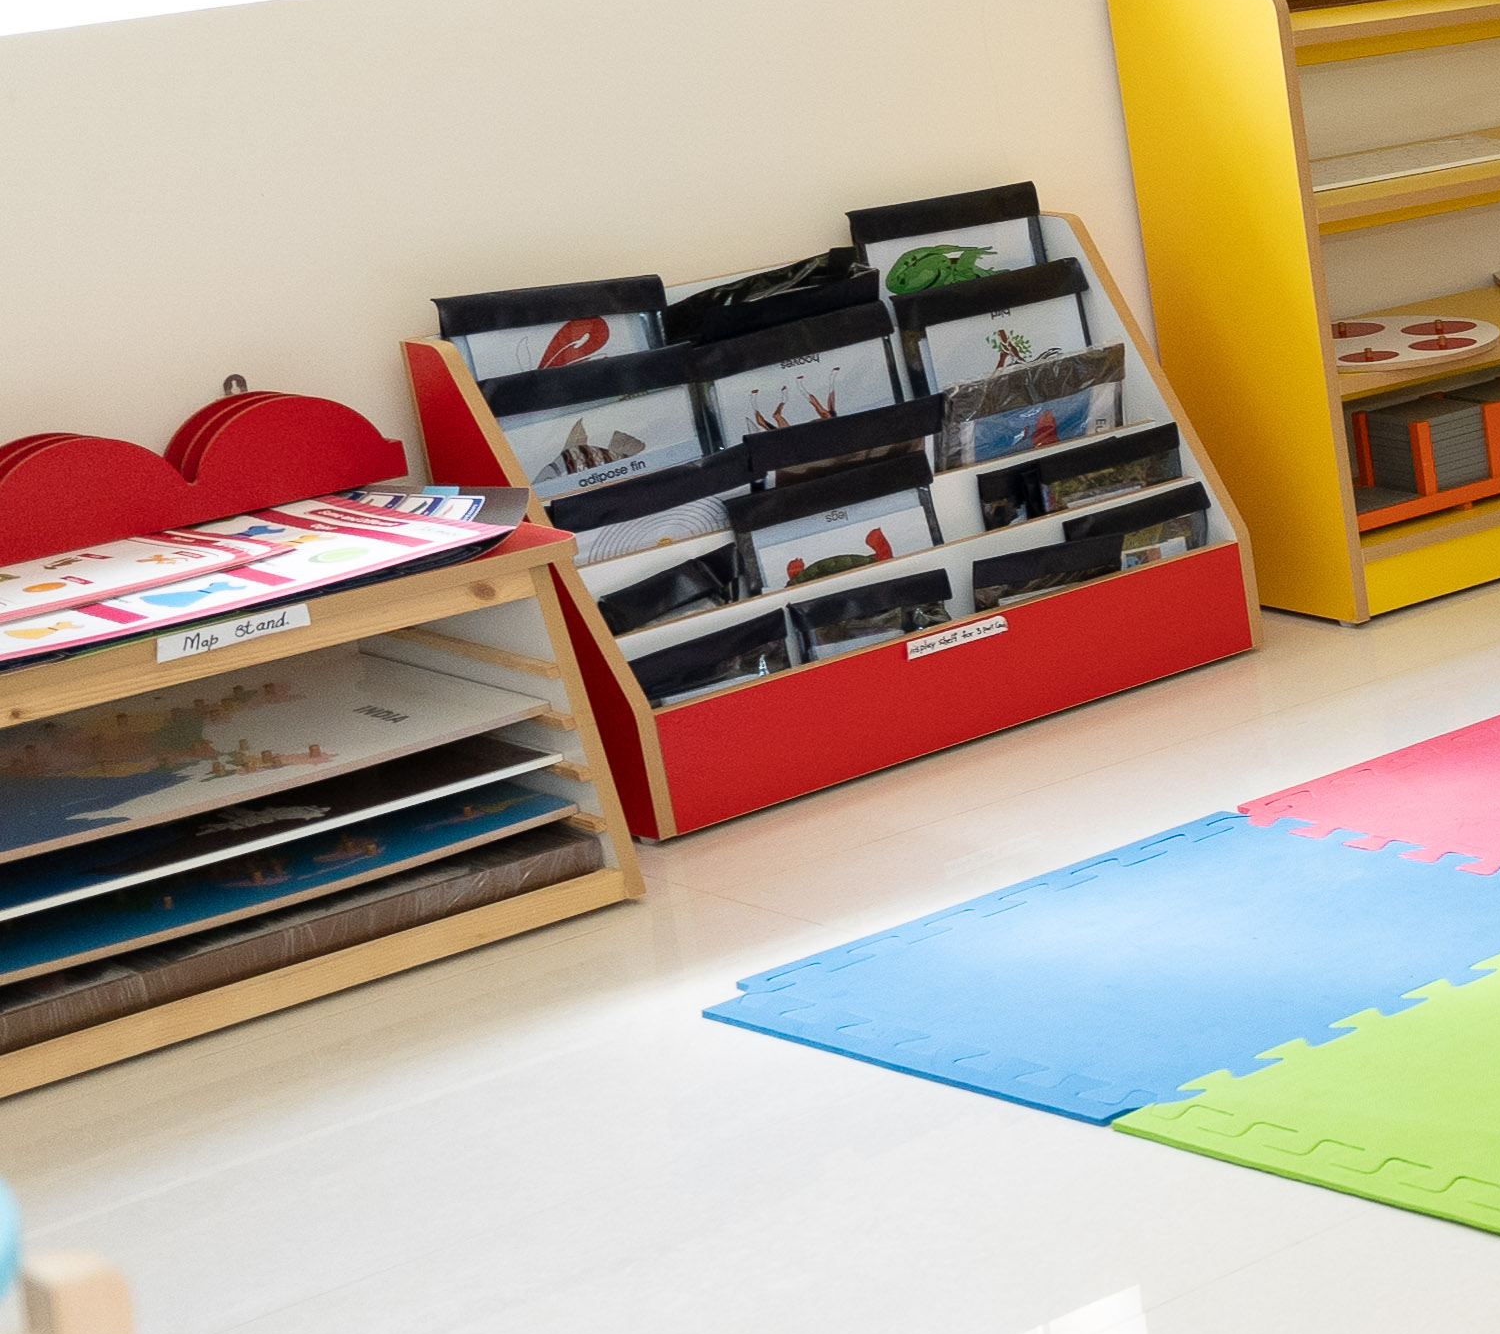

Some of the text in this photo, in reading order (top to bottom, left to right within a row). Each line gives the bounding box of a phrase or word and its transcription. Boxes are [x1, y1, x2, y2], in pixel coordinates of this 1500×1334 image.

[780, 353, 820, 369] hooves
[578, 459, 647, 488] adipose fin
[825, 509, 848, 523] legs
[183, 632, 219, 652] Map
[353, 703, 410, 724] INDIA
